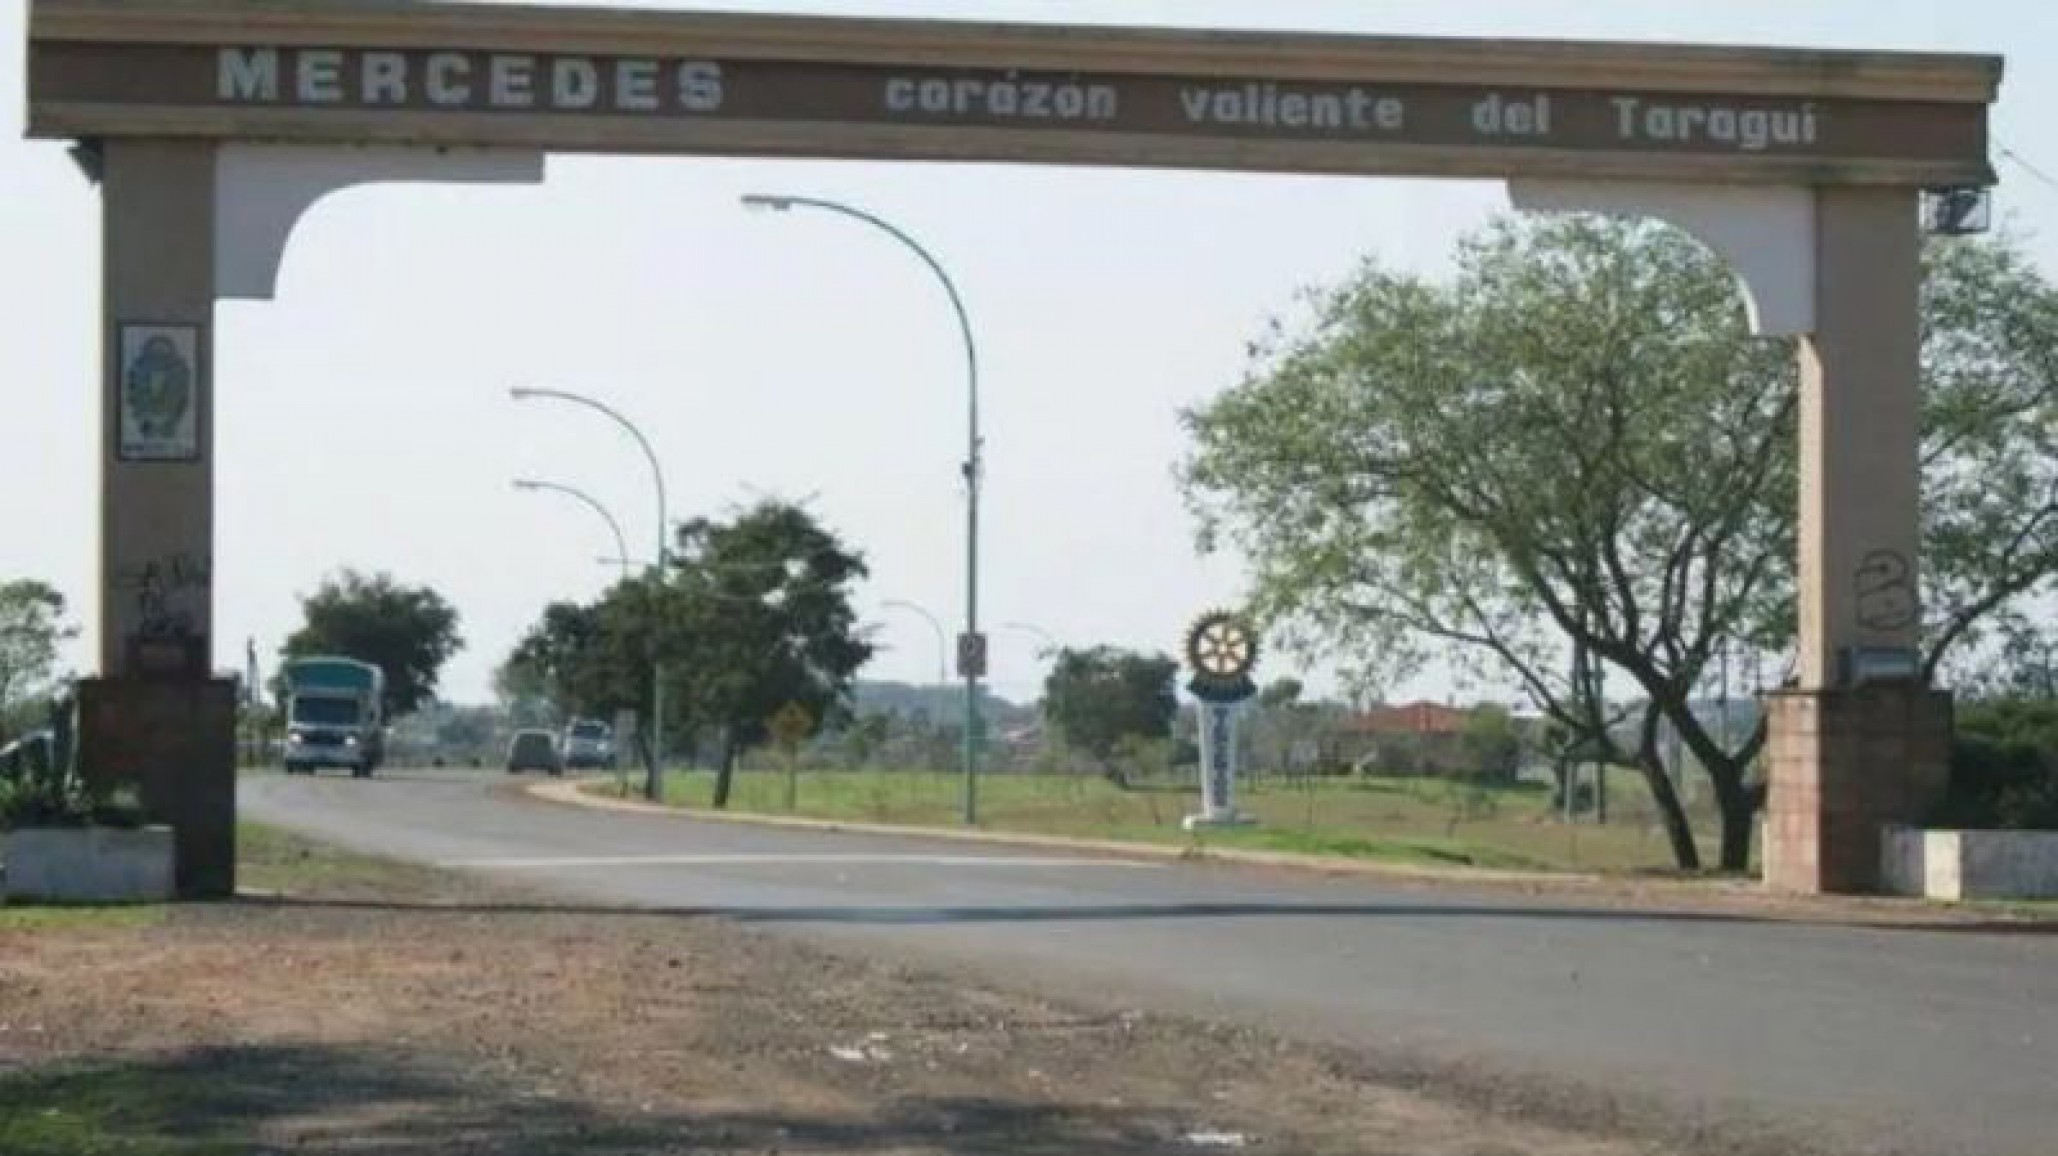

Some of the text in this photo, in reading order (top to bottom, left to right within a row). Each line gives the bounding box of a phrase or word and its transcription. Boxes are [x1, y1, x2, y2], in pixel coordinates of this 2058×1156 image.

[217, 48, 724, 110] MERCEDES
[1180, 84, 1403, 129] valiente
[1471, 93, 1549, 134] del
